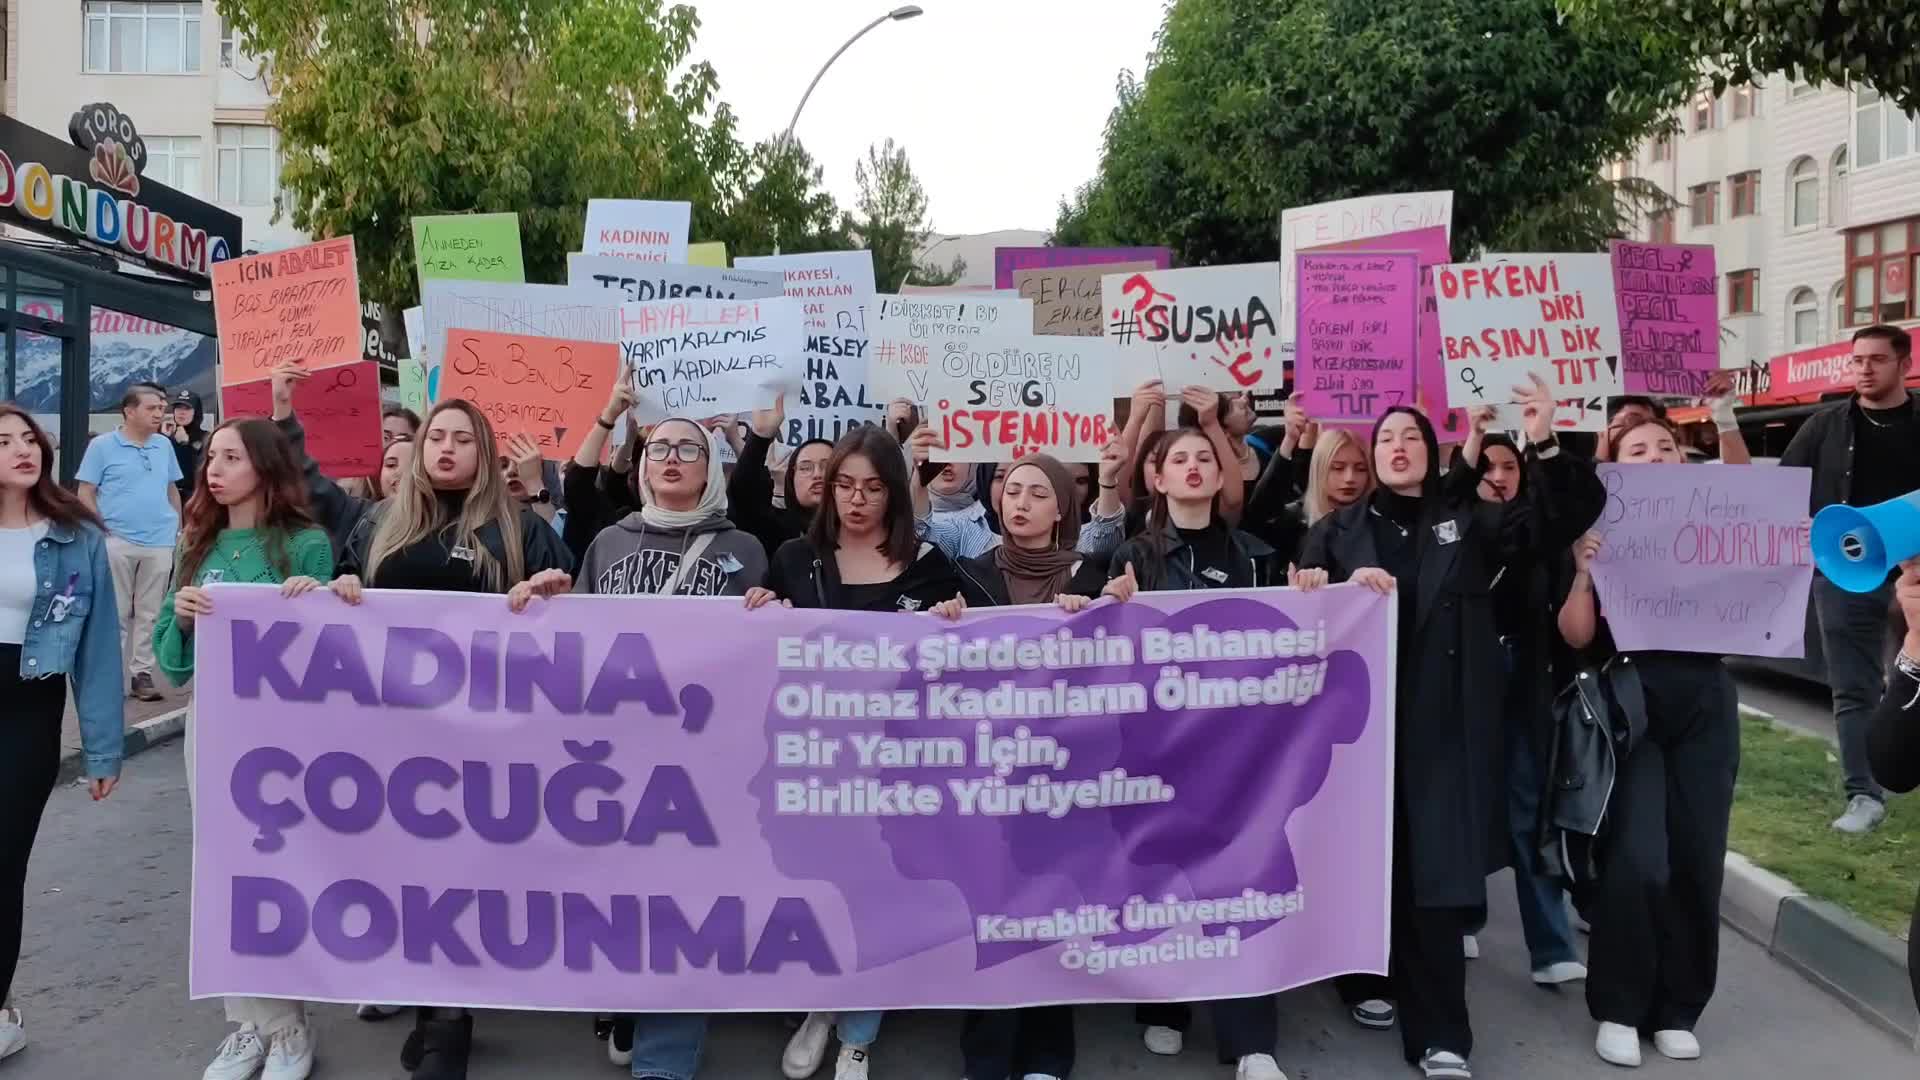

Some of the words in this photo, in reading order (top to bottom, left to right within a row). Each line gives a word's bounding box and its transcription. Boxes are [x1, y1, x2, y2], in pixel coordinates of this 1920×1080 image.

[84, 108, 142, 161] TOROS
[600, 229, 671, 246] KADININ
[278, 243, 350, 278] ADALET
[1439, 260, 1560, 300] ÖFKENİ
[807, 284, 853, 298] KALAN
[1539, 290, 1585, 322] DİRİ
[1110, 296, 1277, 345] #SUSMA
[621, 335, 678, 366] YARIM
[802, 335, 868, 358] MESEY
[942, 342, 1081, 381] ÖLDÜREN
[1444, 327, 1550, 362] BAŞINI
[1560, 324, 1602, 353] DİK
[630, 363, 666, 392] TÜM
[673, 353, 784, 381] KADINLAR
[802, 358, 839, 381] HA
[776, 635, 911, 672] Erkek
[916, 627, 1135, 681] Şiddetinin
[1140, 619, 1328, 664] Bahanesi
[231, 618, 714, 733] KADINA,
[776, 684, 920, 721] Olmaz
[926, 675, 1148, 720] Kadınların
[1153, 660, 1328, 711] Ölmediği
[776, 730, 841, 767] Bir
[850, 733, 967, 768] Yarın
[974, 719, 1071, 777] İçin,
[231, 739, 719, 854] ÇOCUĞA
[776, 777, 943, 816] Birlikte
[948, 767, 1176, 819] Yürüyelim.
[231, 875, 842, 976] DOKUNMA
[977, 905, 1120, 943] Karabük
[1122, 886, 1306, 928] Üniversitesi
[1059, 927, 1241, 975] Öğrencileri
